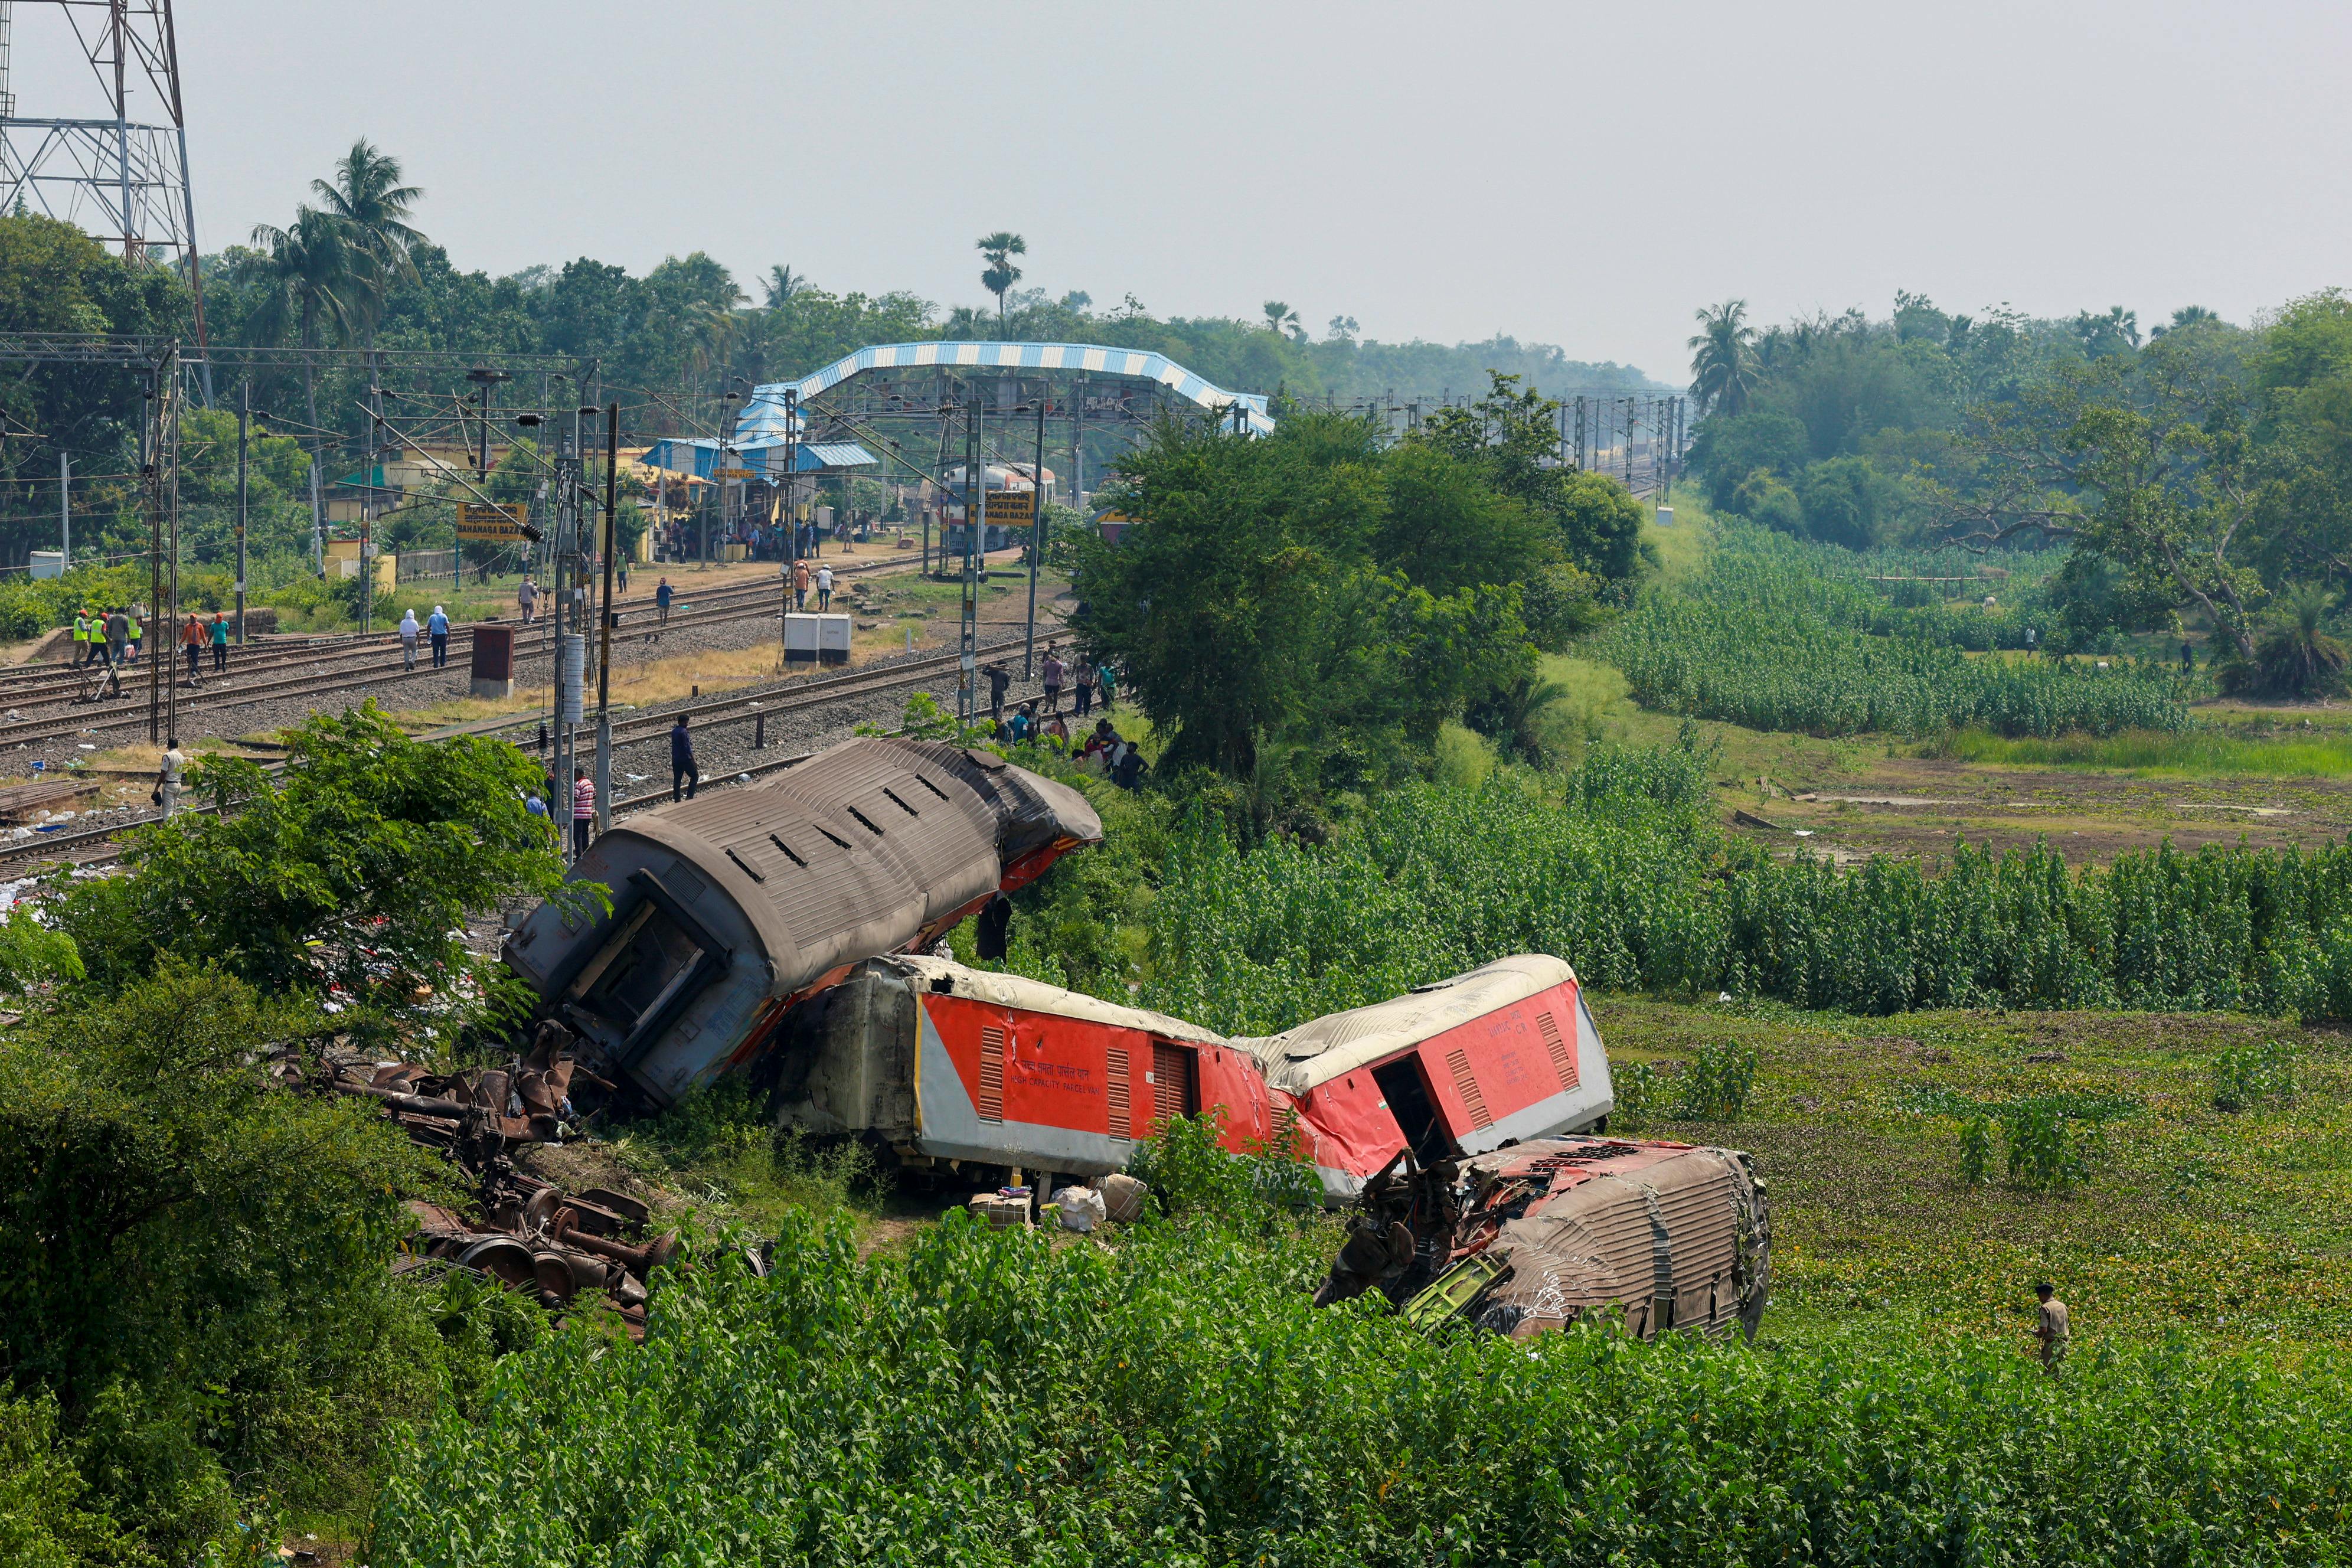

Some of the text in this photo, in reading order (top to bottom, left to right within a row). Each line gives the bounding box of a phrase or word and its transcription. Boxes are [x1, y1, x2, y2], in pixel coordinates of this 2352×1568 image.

[458, 525, 520, 534] BAHANAGA BAZA
[1038, 1062, 1054, 1076] क्षमता
[1057, 1062, 1075, 1079] पार्सल
[1077, 1068, 1090, 1082] यान
[1011, 1075, 1100, 1096] HIGH CAPACITY PARCEL VAN
